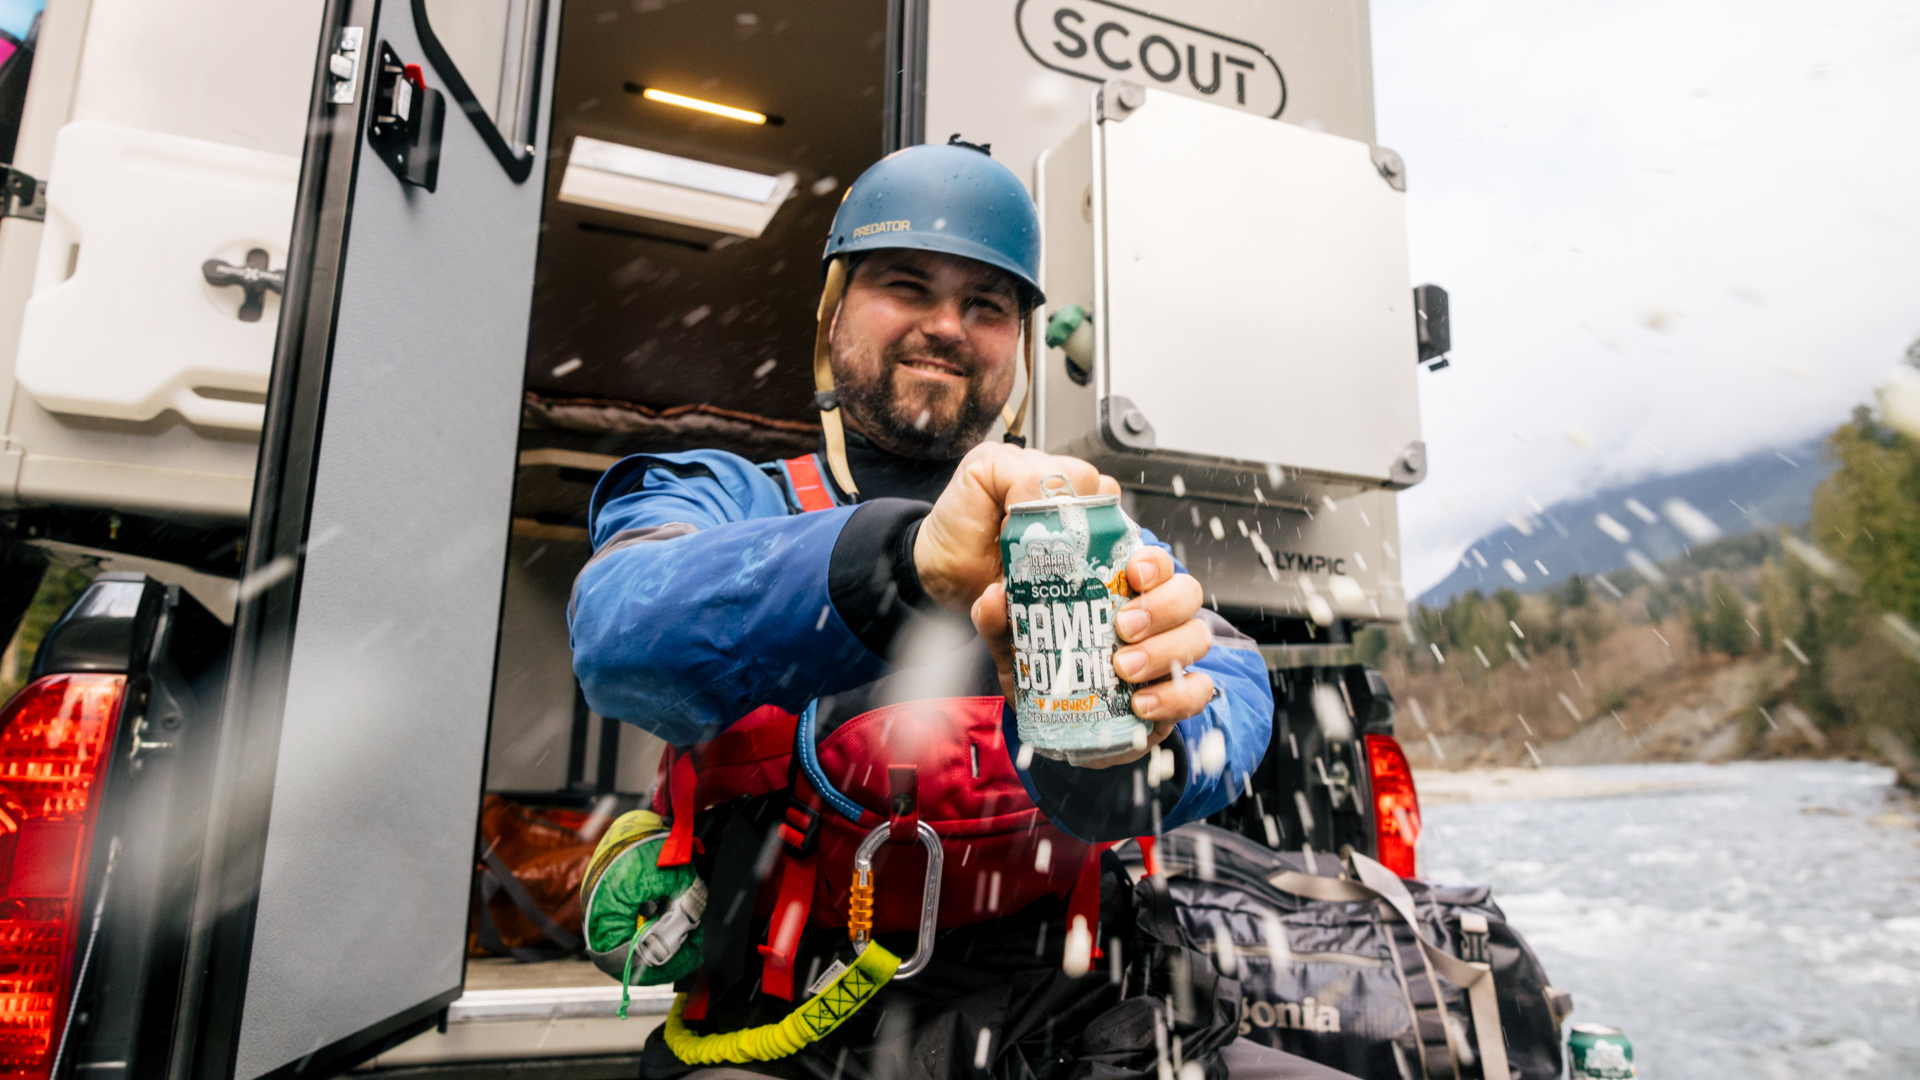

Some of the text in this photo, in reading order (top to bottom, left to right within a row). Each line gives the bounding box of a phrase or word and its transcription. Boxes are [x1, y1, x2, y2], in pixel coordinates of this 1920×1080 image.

[1053, 8, 1255, 105] SCOUT
[852, 220, 911, 239] PREDATOR
[1031, 565, 1066, 576] BREWING
[1010, 599, 1114, 651] CAMP
[1028, 711, 1113, 724] NORTHWEST IPA
